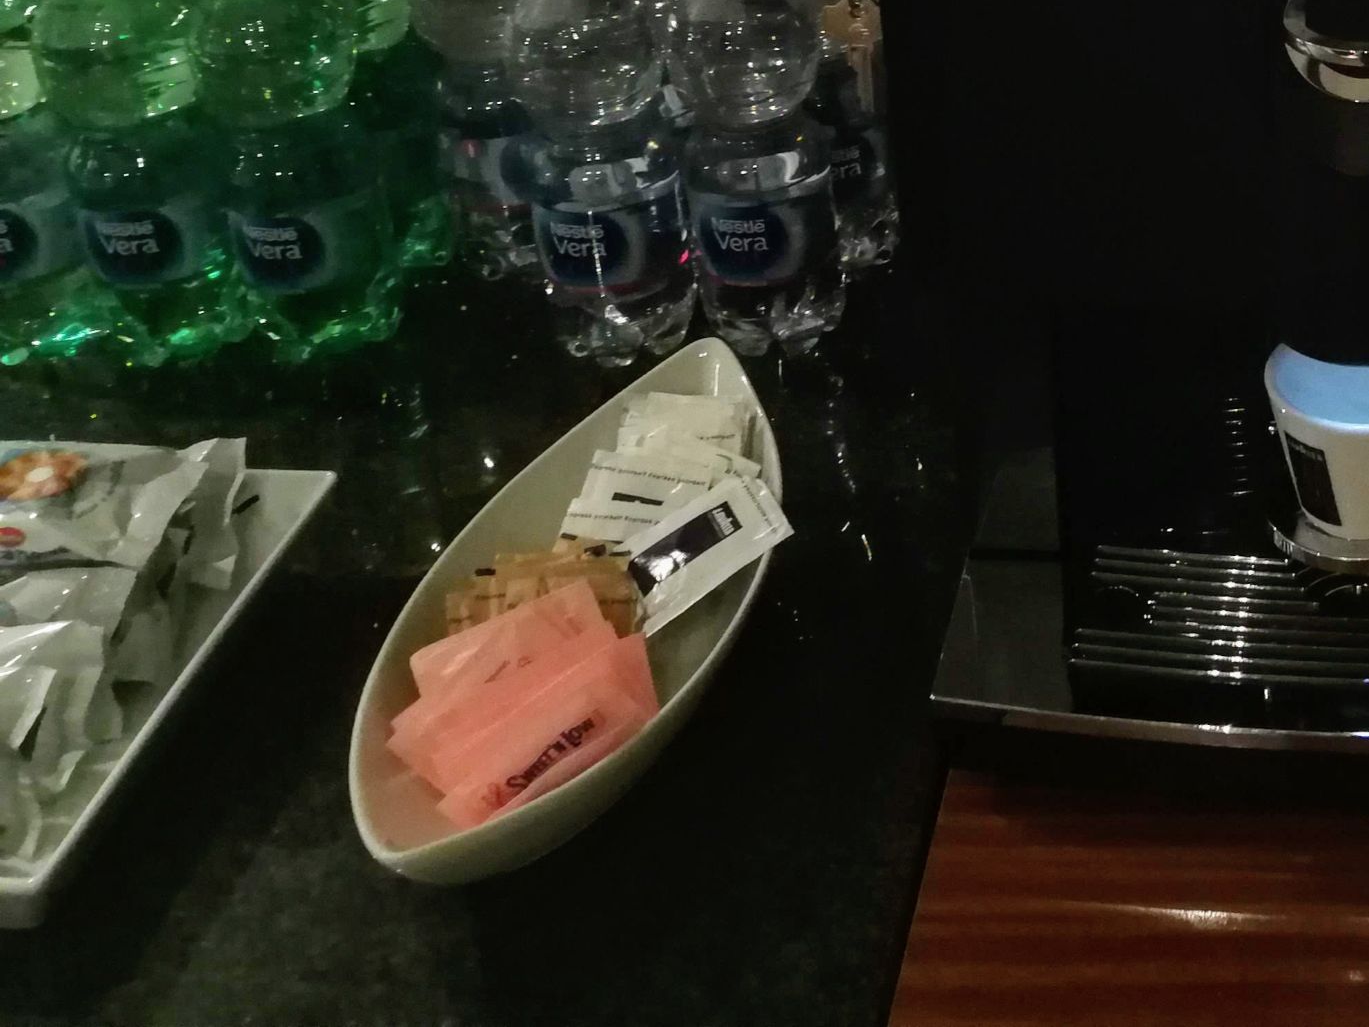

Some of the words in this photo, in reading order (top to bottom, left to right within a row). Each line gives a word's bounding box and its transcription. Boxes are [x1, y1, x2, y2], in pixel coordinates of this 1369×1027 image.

[102, 236, 160, 256] Vera
[252, 241, 302, 260] Vera
[554, 236, 607, 258] Vera
[716, 234, 769, 253] Vera
